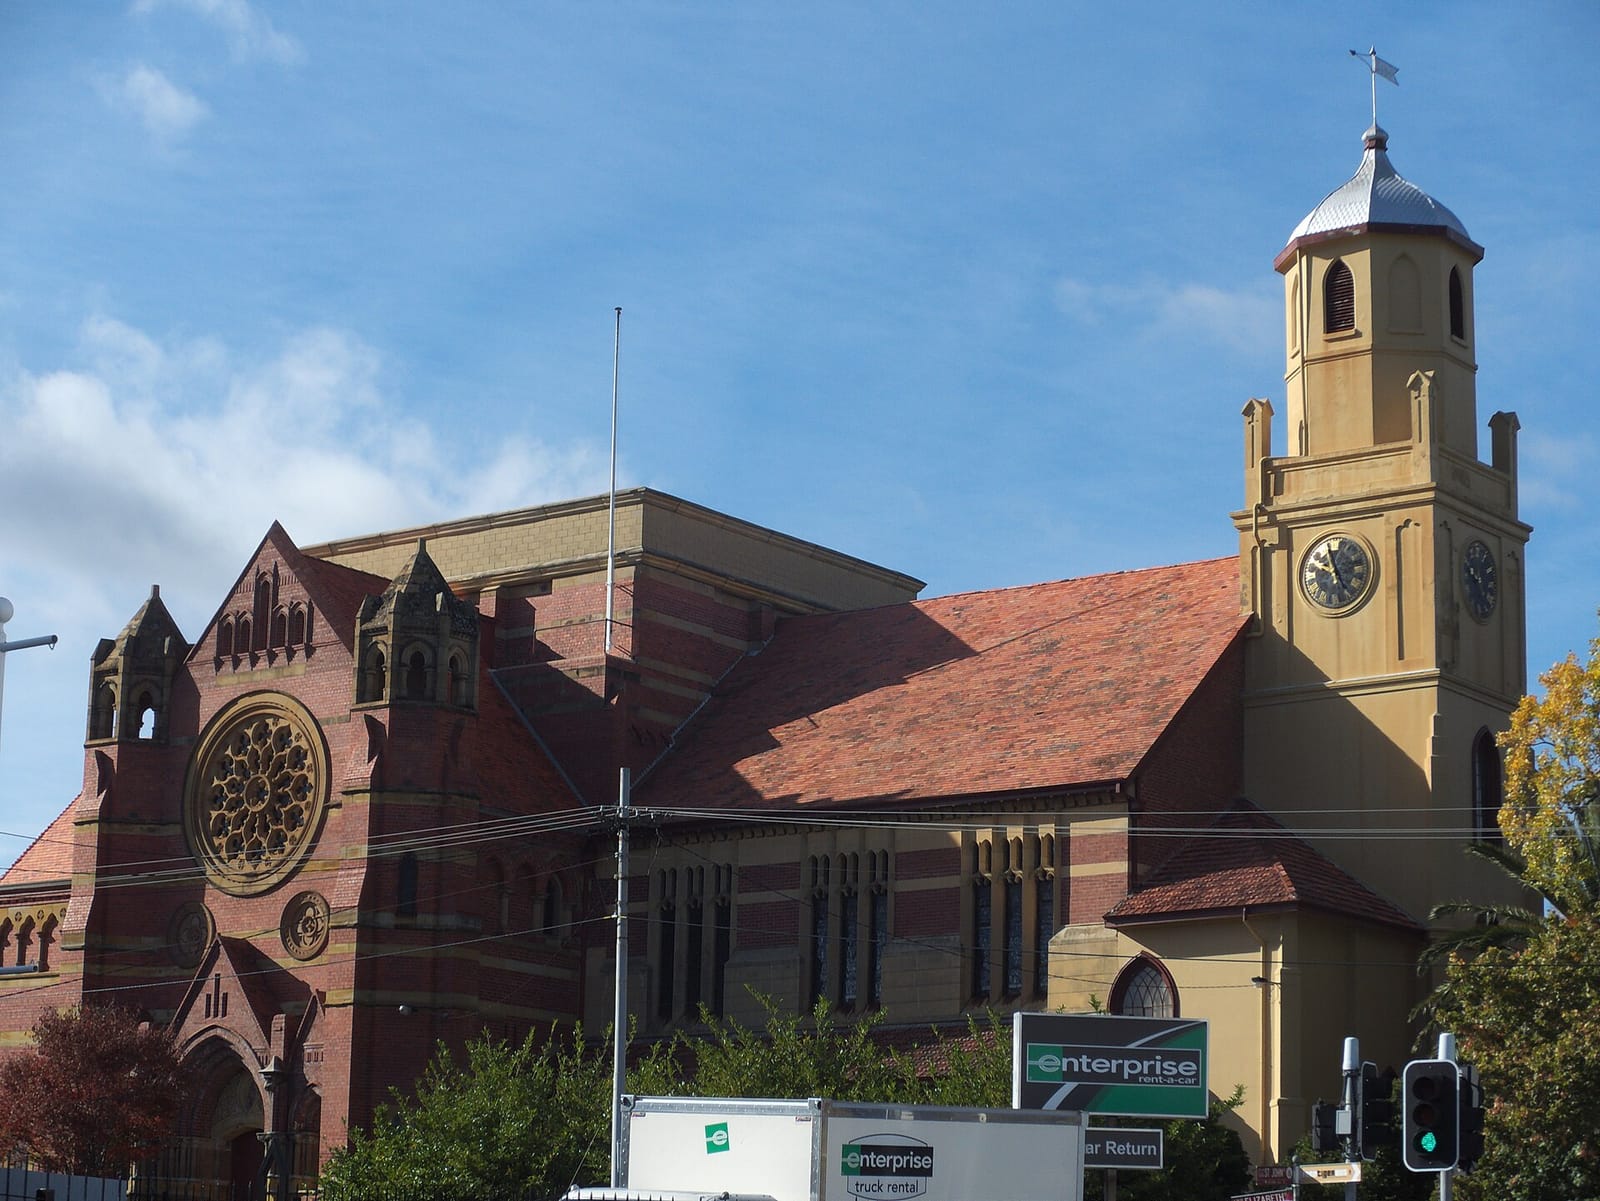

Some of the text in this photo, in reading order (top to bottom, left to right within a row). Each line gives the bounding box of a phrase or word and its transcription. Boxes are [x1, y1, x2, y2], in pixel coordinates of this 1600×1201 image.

[1038, 1055, 1198, 1080] enterprise
[1138, 1076, 1197, 1085] rent-a-car
[1085, 1140, 1158, 1156] ar Return
[847, 1151, 932, 1173] enterprise
[855, 1179, 919, 1193] truck rental
